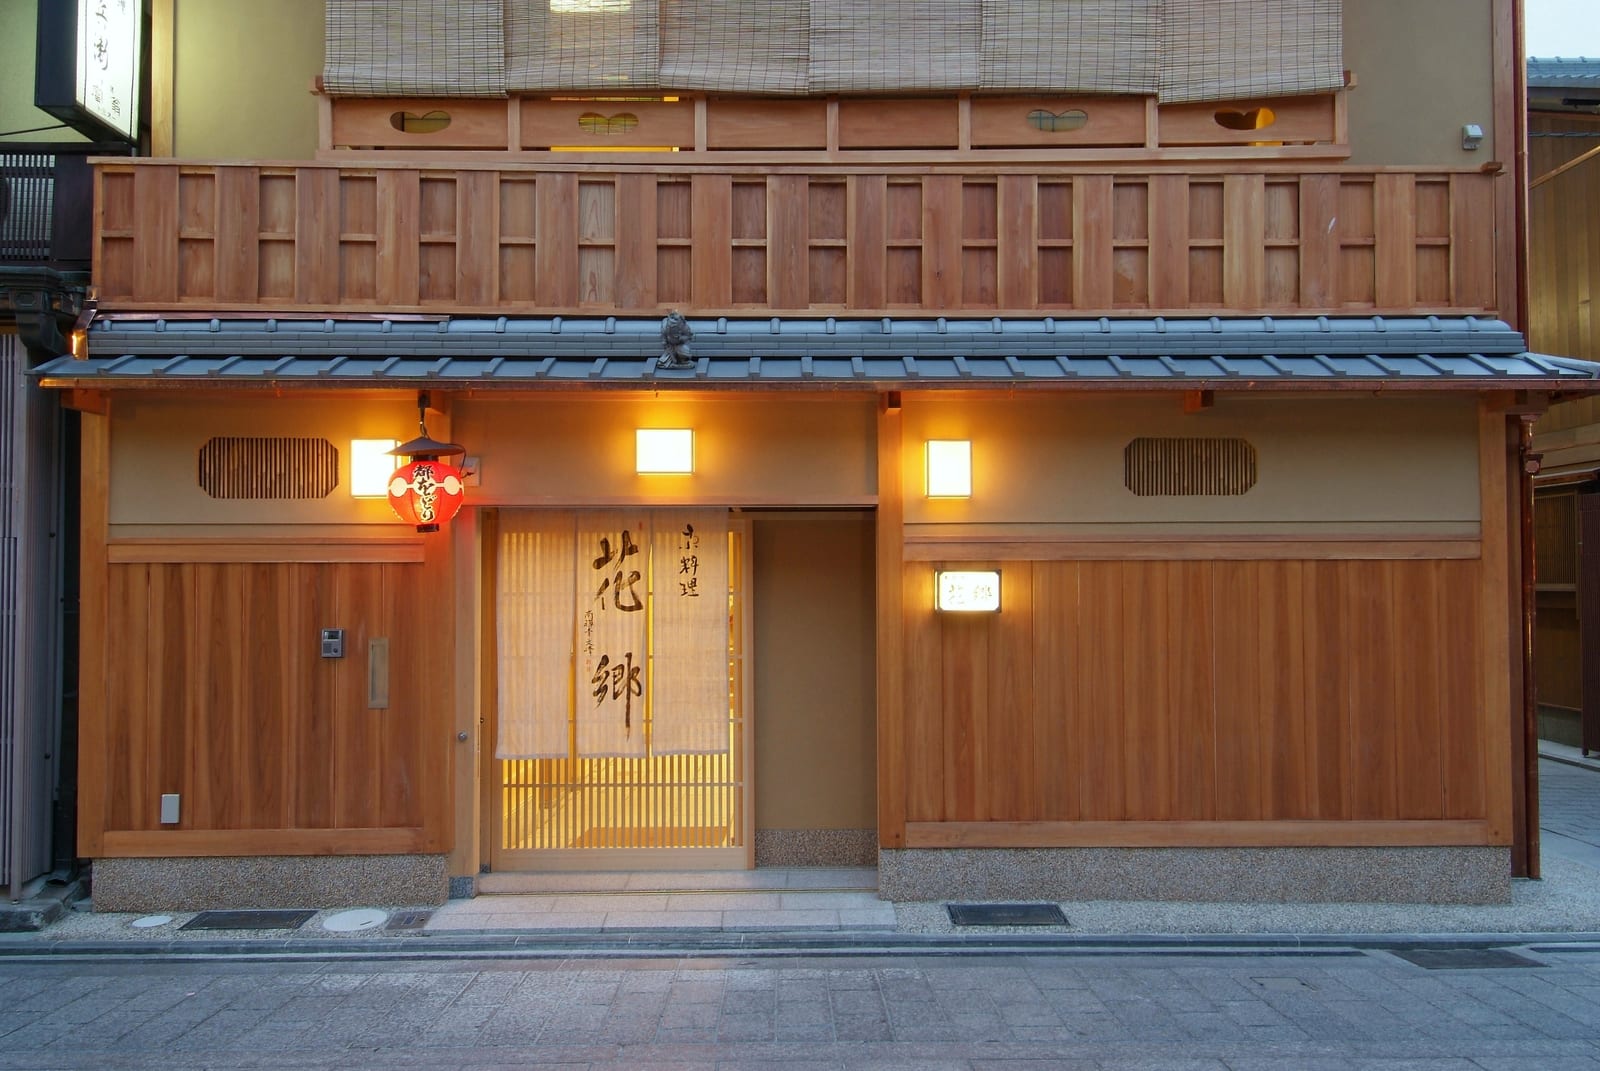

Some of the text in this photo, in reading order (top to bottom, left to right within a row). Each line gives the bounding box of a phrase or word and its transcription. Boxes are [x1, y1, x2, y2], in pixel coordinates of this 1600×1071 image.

[414, 465, 437, 521] 都をどり
[679, 524, 699, 597] 京料理
[592, 530, 643, 741] 花郷
